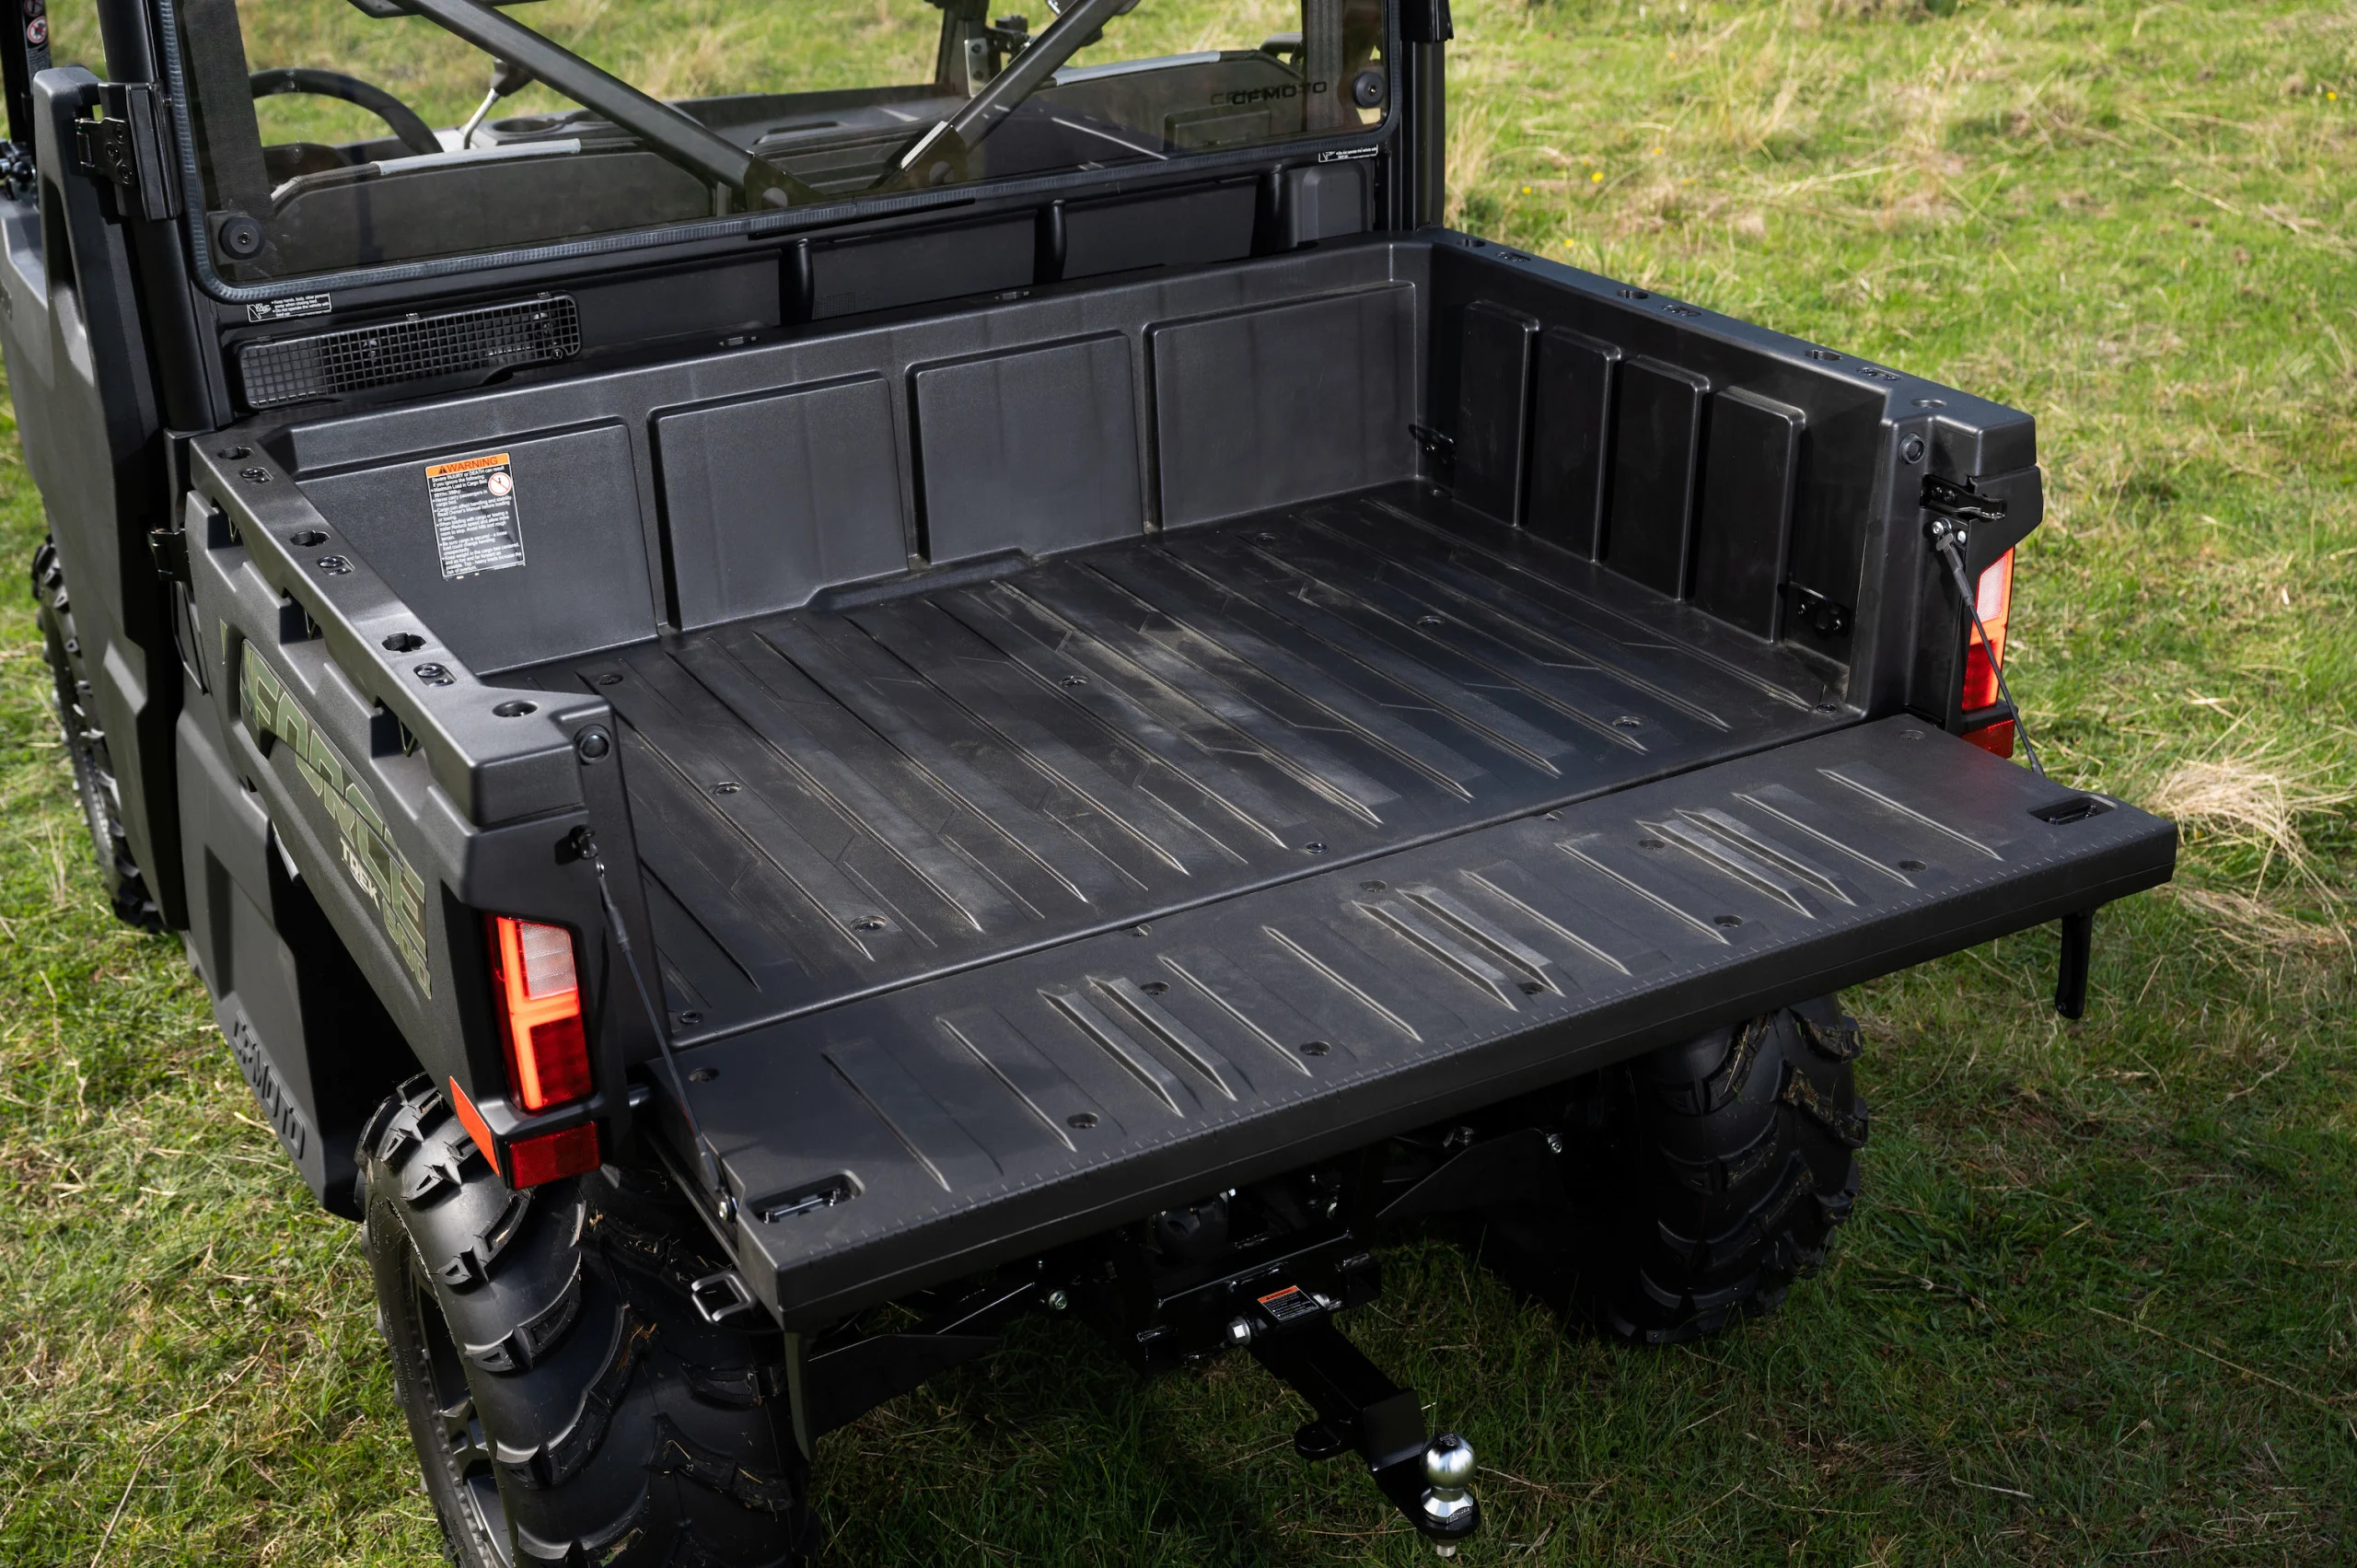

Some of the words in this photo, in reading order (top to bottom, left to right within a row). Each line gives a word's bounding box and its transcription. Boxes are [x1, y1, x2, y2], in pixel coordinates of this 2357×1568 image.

[1233, 82, 1328, 105] CFMOTO
[447, 457, 498, 472] WARNING
[340, 832, 380, 912] TREK
[234, 1011, 306, 1159] CFMOTO
